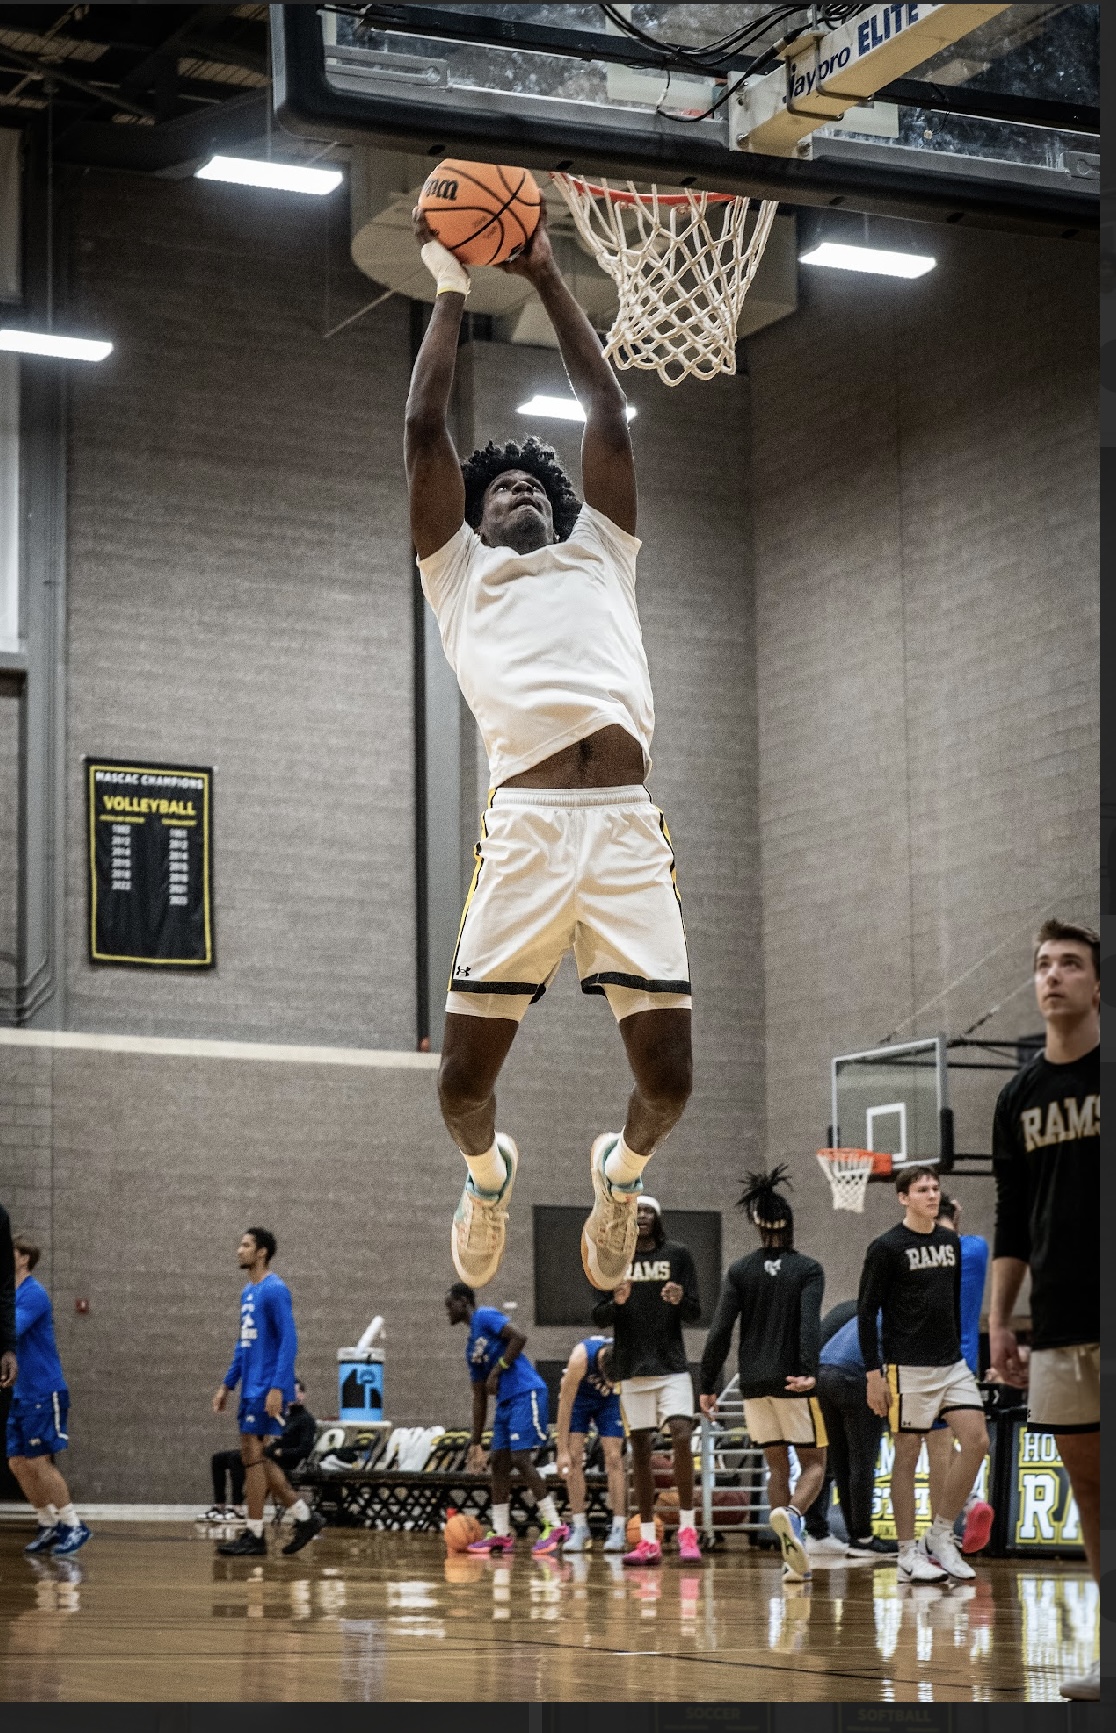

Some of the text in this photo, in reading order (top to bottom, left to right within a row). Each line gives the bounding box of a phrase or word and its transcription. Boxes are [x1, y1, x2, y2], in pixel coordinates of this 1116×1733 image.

[858, 4, 918, 57] ELITE
[103, 795, 196, 816] VOLLEYBALL
[905, 1244, 955, 1270] RAMS
[1023, 1433, 1062, 1462] HO
[685, 1706, 741, 1720] SOCCER
[857, 1708, 932, 1722] SOFTBALL
